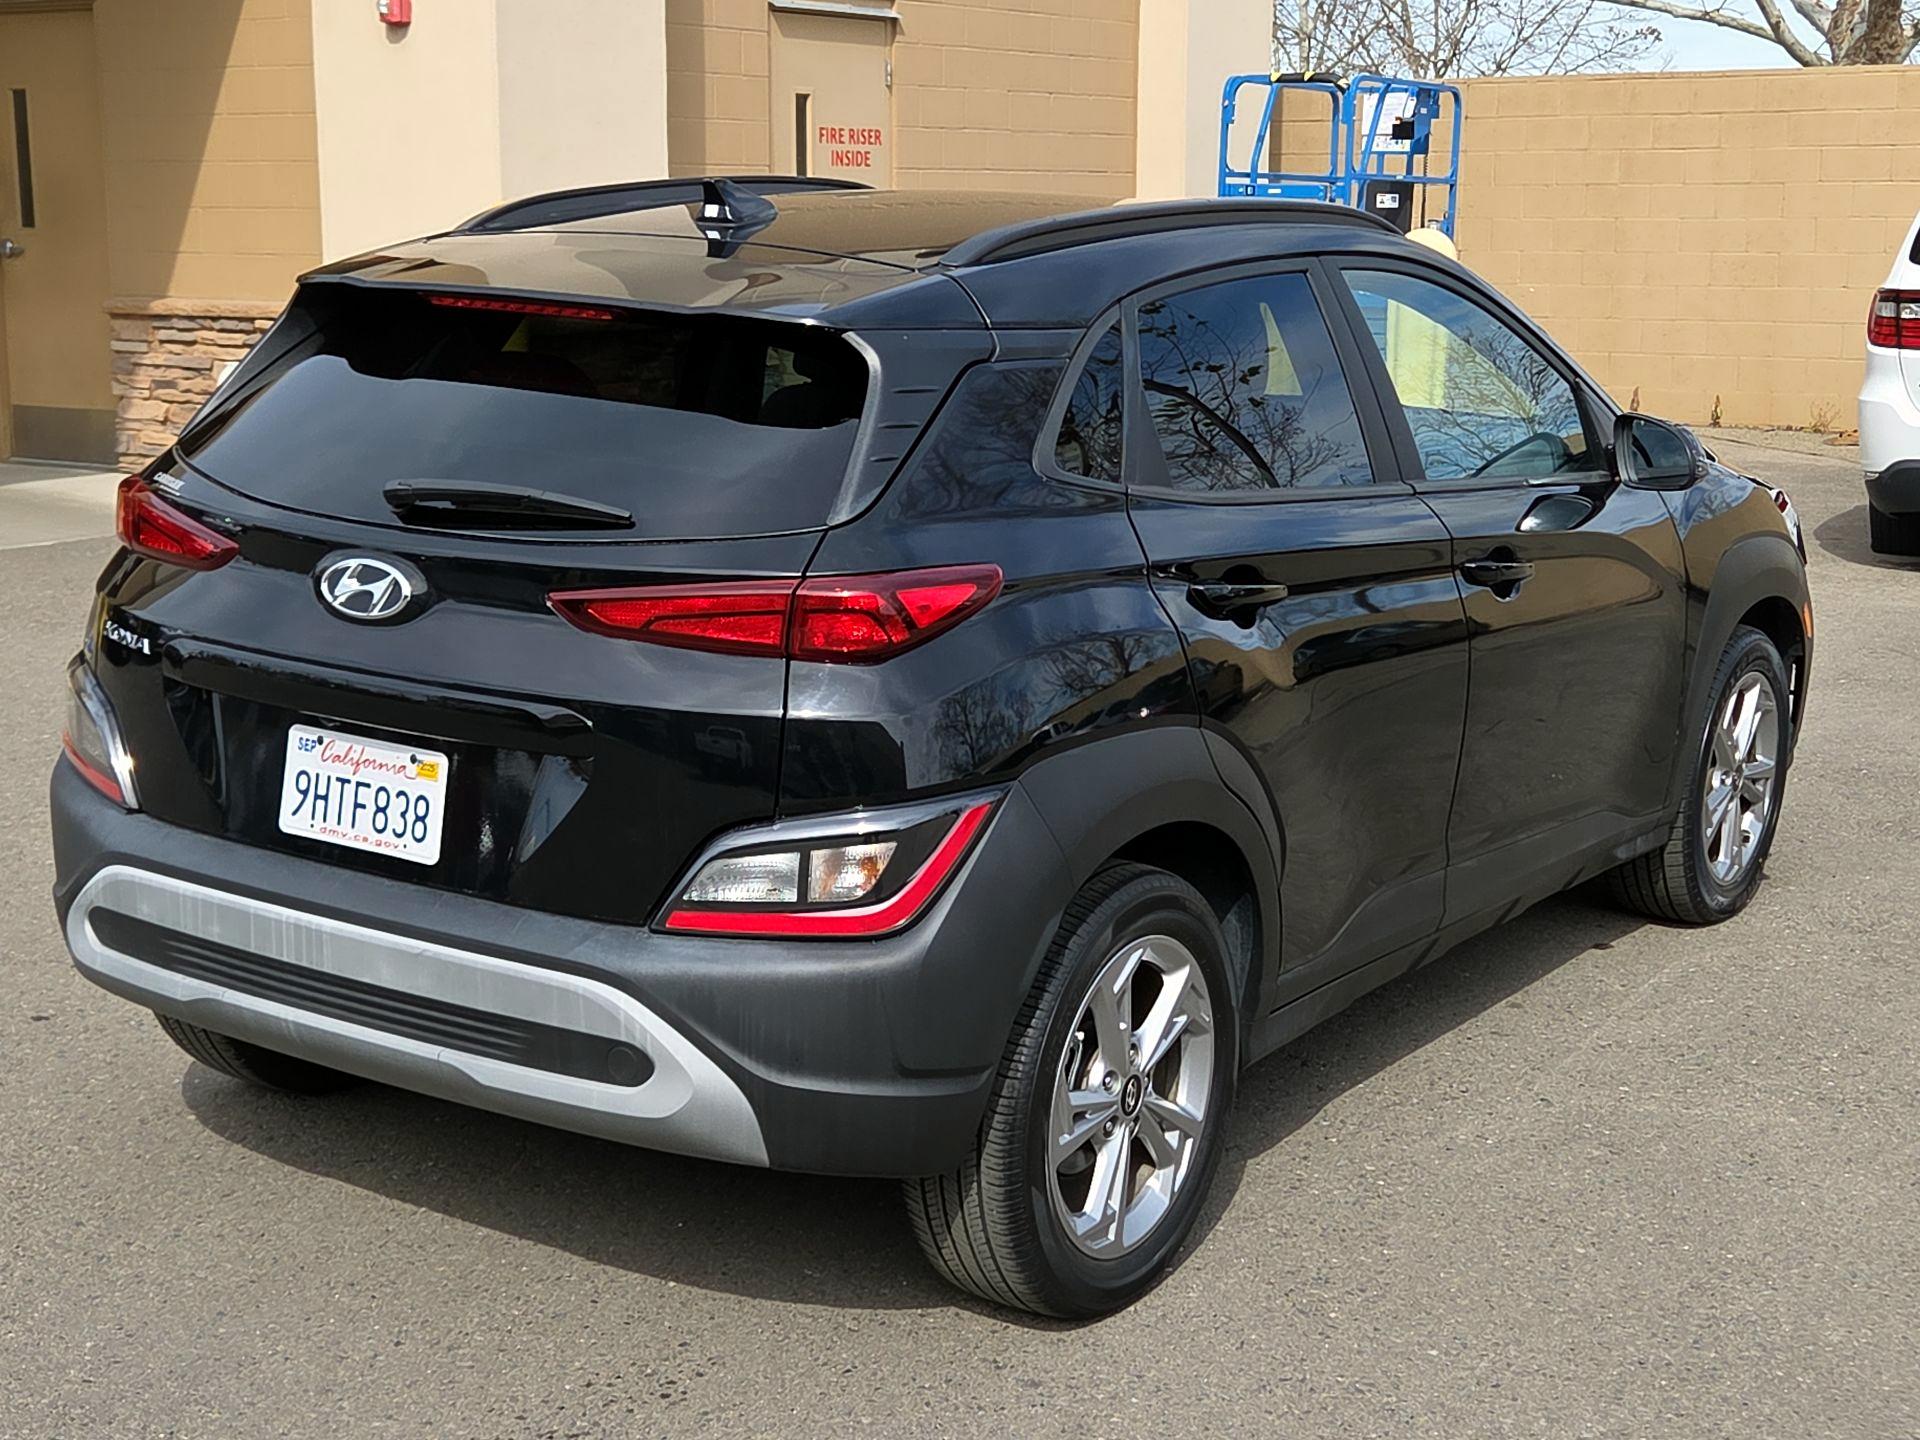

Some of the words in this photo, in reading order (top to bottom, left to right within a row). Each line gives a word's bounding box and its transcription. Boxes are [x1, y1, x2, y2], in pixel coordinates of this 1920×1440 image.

[818, 126, 846, 145] FIRE
[848, 128, 882, 146] RISER
[831, 150, 871, 168] INSIDE
[298, 737, 317, 752] SEP
[320, 739, 417, 780] California
[291, 769, 430, 843] 9HTF838
[319, 826, 400, 850] dmv.ca.gov
